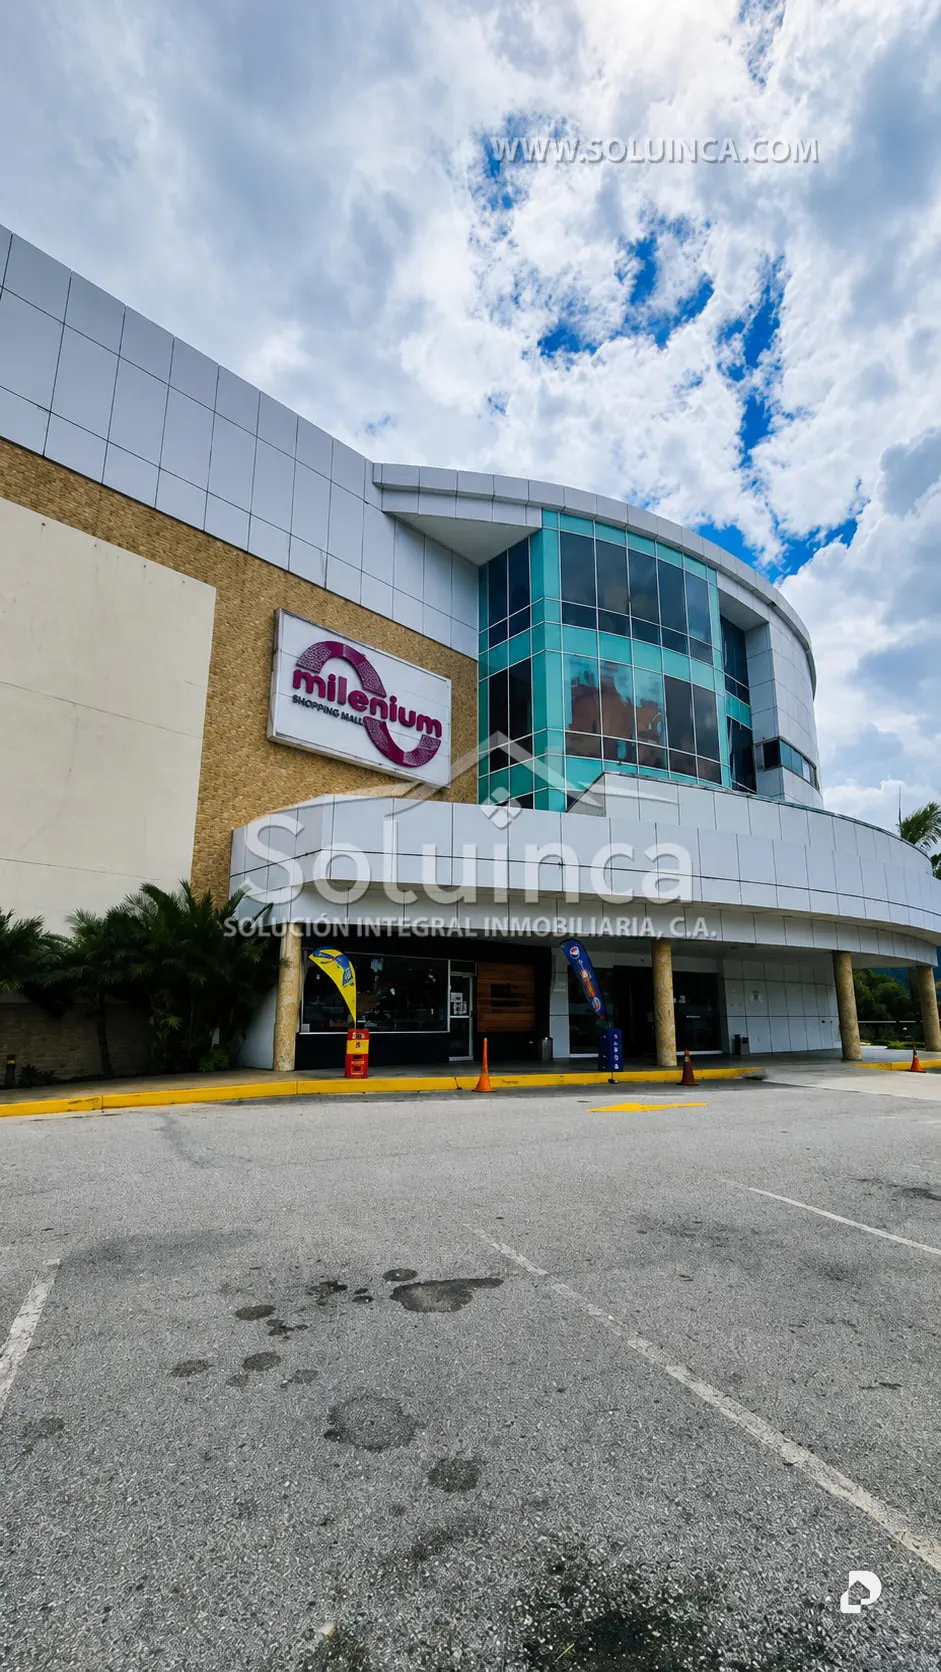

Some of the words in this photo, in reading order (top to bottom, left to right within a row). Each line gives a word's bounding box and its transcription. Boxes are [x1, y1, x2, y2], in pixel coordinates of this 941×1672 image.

[292, 669, 442, 738] milenium
[292, 695, 340, 718] SHOPPING
[340, 711, 364, 726] MALL
